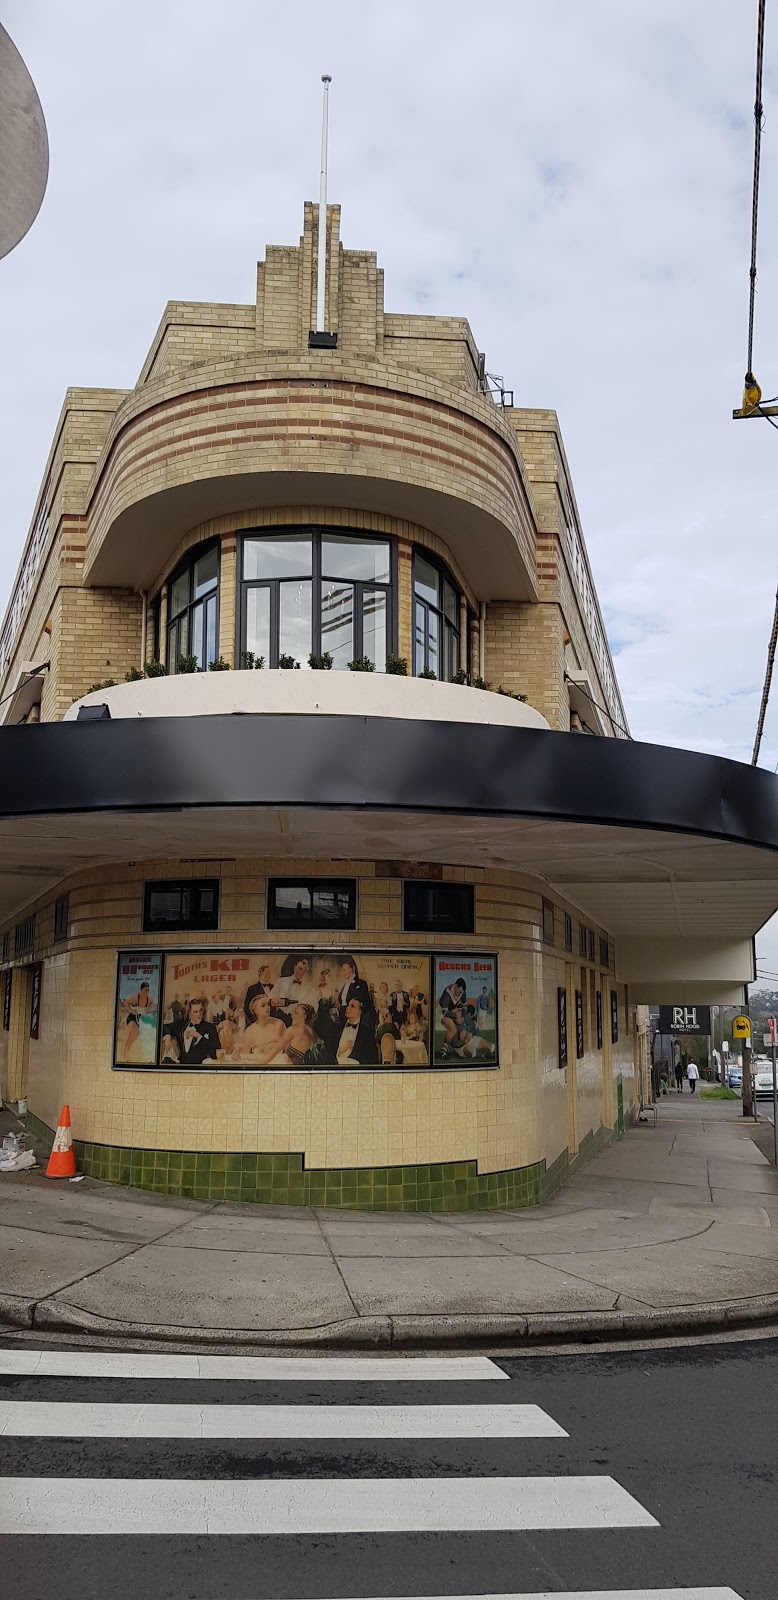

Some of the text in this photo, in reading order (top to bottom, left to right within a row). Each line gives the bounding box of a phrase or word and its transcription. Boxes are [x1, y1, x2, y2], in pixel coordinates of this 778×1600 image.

[210, 959, 250, 971] KB
[473, 962, 492, 972] BEER
[194, 974, 236, 983] LAGER
[672, 1007, 697, 1024] RH
